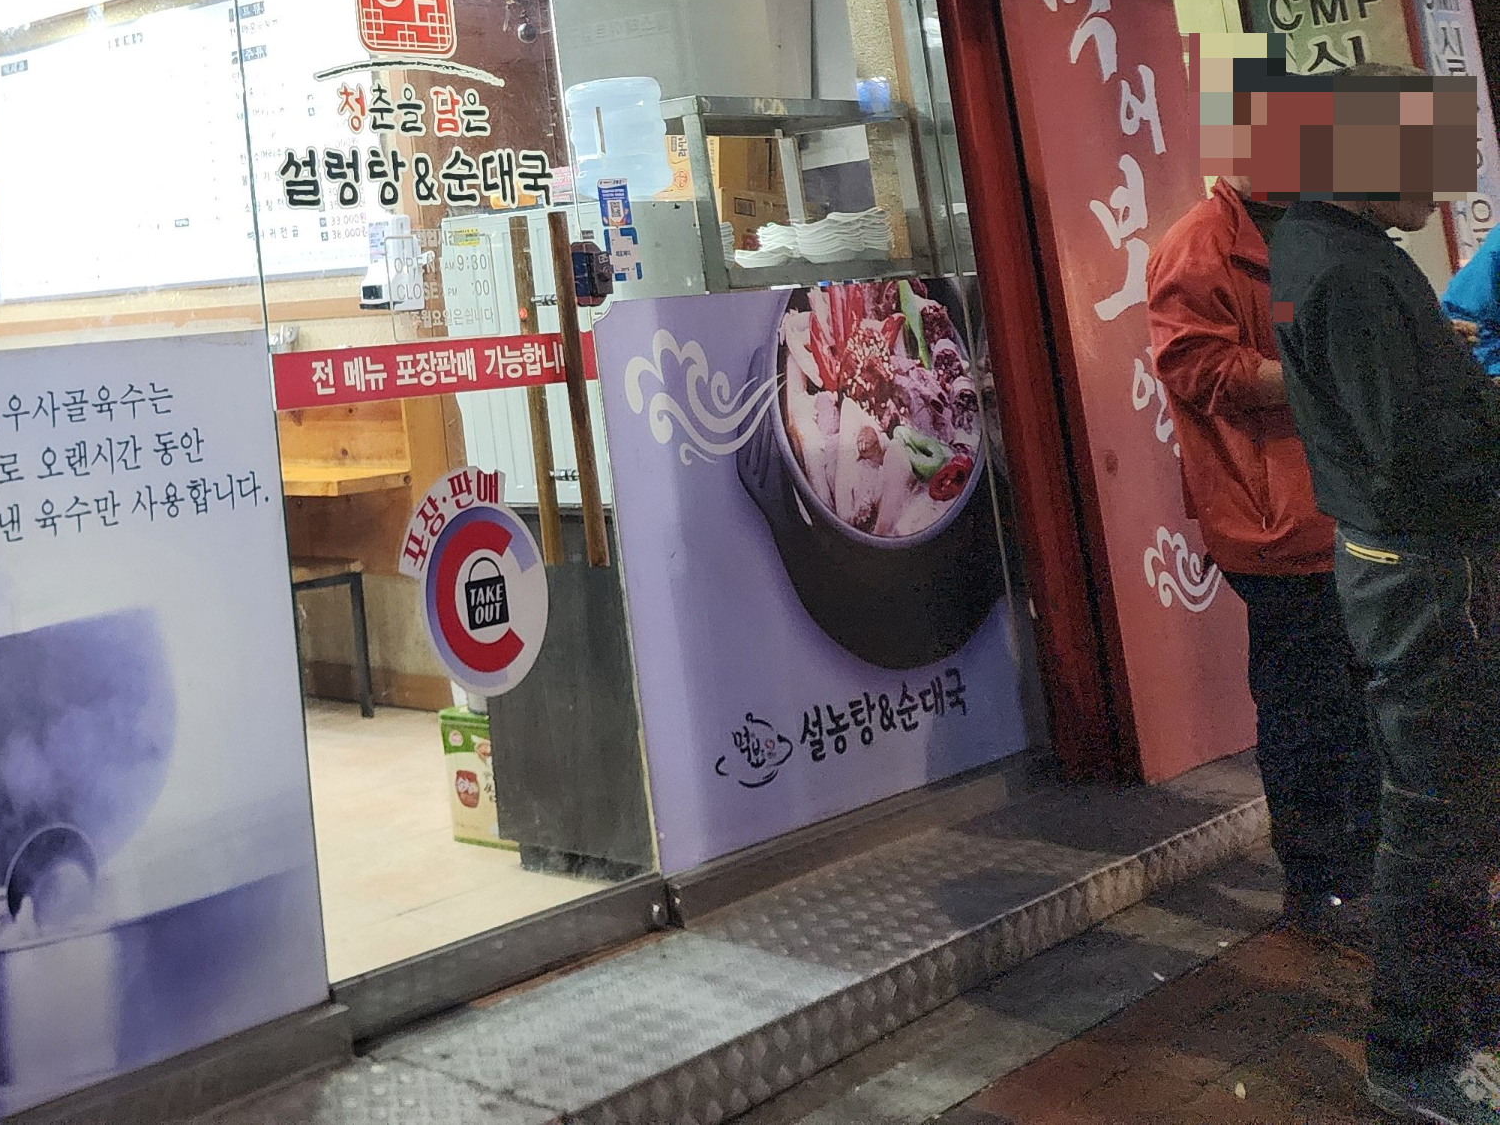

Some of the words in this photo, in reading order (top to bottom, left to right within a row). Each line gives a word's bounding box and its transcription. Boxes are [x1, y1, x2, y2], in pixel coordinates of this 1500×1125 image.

[338, 84, 424, 133] 청춘을
[433, 86, 490, 135] 담은
[457, 253, 487, 272] 9:30
[311, 359, 336, 396] 전
[343, 356, 388, 392] 메뉴
[396, 347, 477, 387] 포장판매
[485, 340, 566, 377] 가능합니
[36, 434, 143, 480] 오랜시간
[153, 426, 205, 468] 동안
[34, 489, 121, 538] 육수만
[130, 470, 270, 523] 사용합니다.
[468, 583, 504, 608] TAKE
[473, 602, 503, 626] OUT
